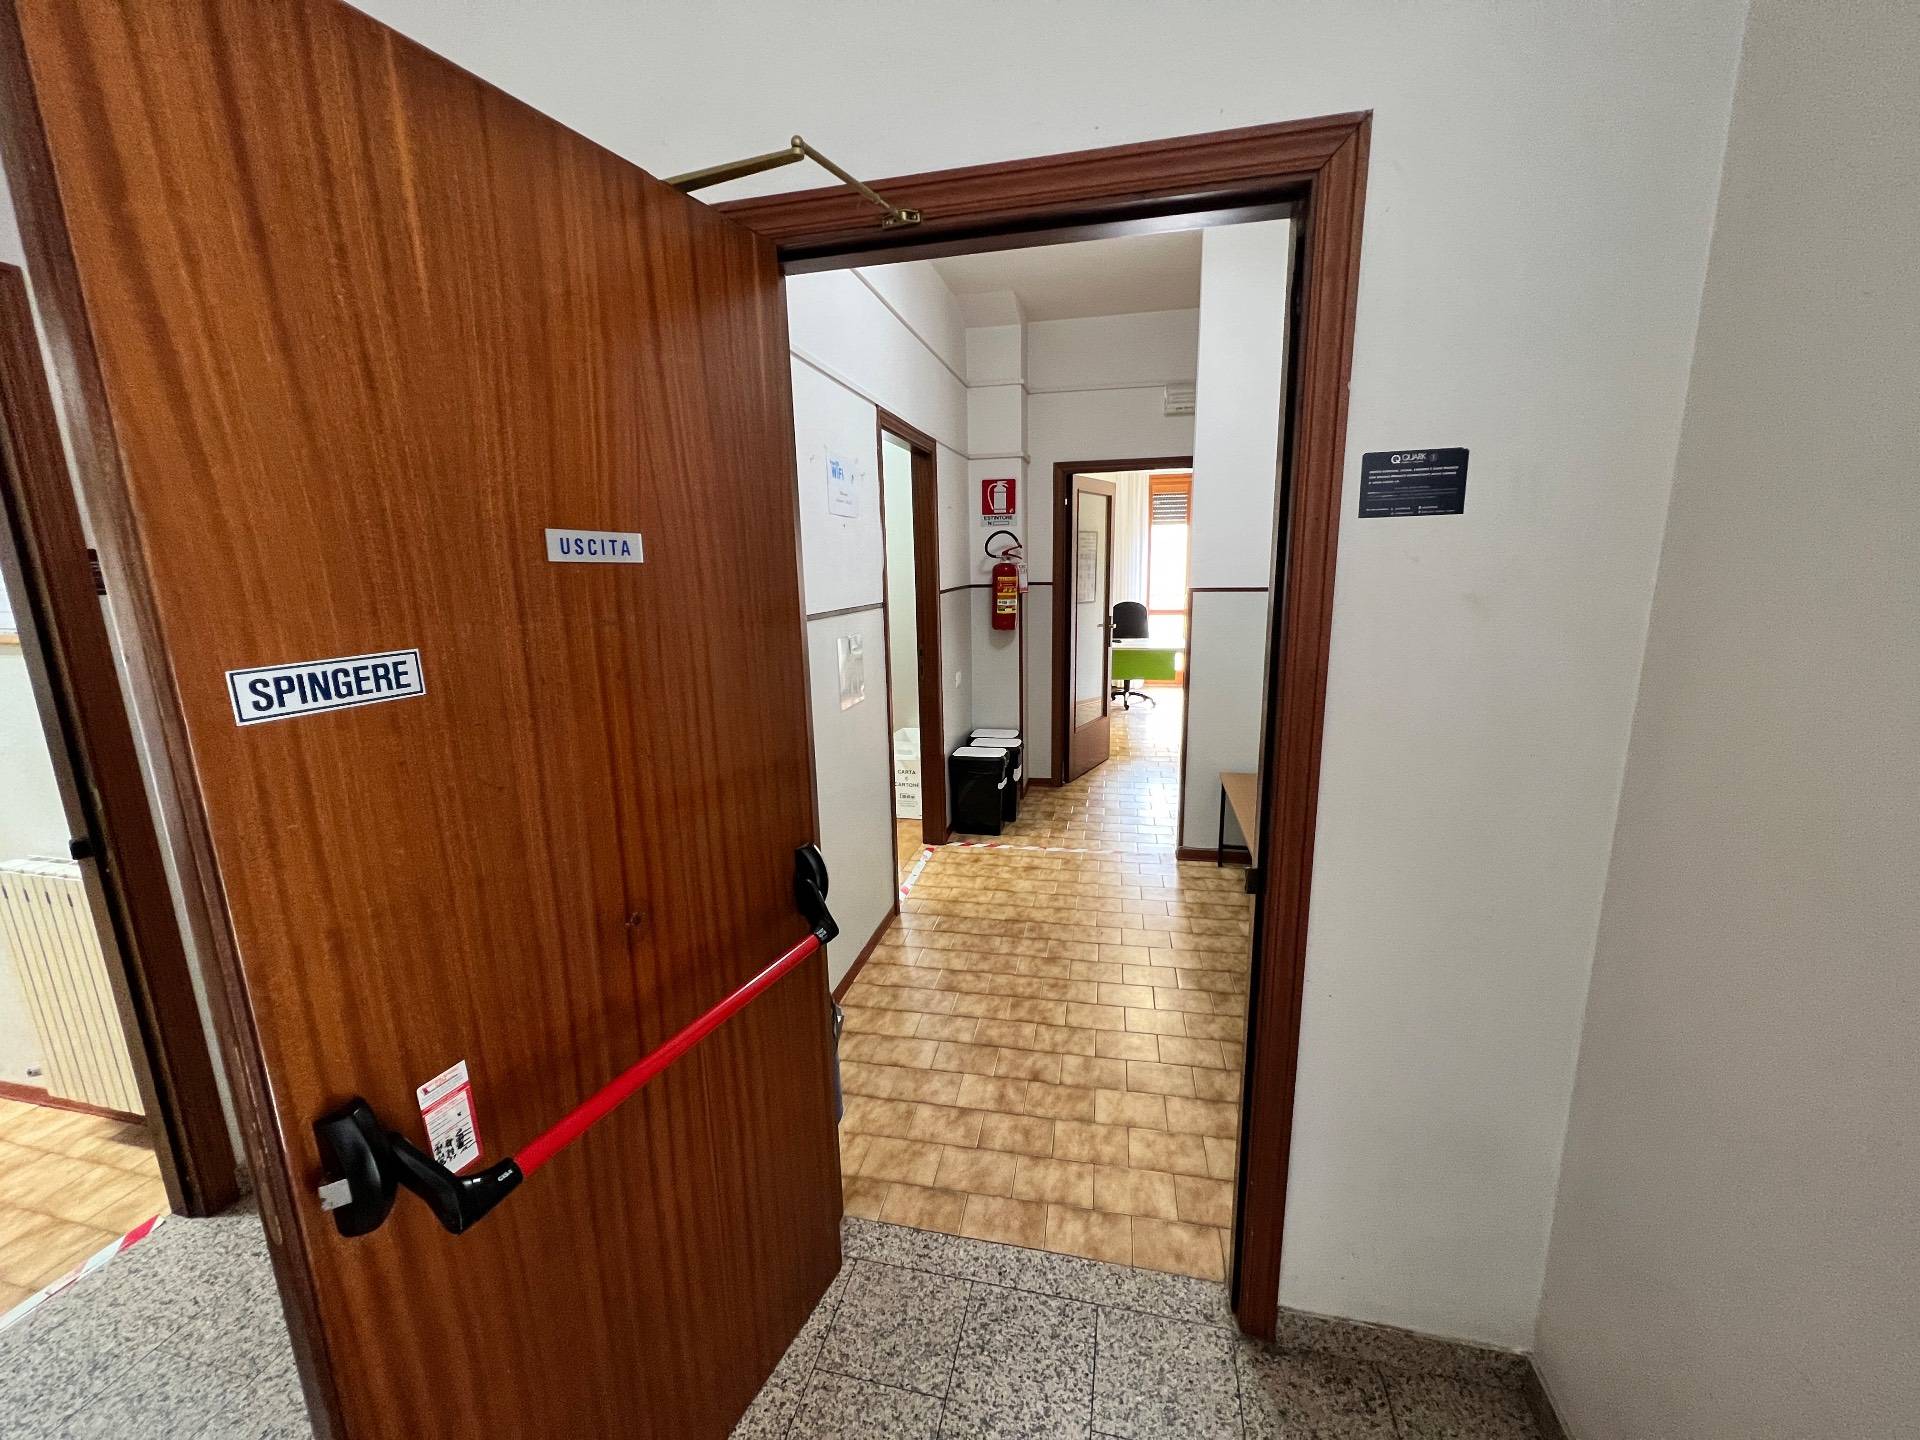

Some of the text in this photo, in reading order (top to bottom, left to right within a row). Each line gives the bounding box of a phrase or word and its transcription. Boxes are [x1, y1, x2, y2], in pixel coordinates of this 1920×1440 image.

[1401, 453, 1426, 461] QUARK
[559, 537, 631, 556] USCITA
[248, 660, 412, 712] SPINGERE
